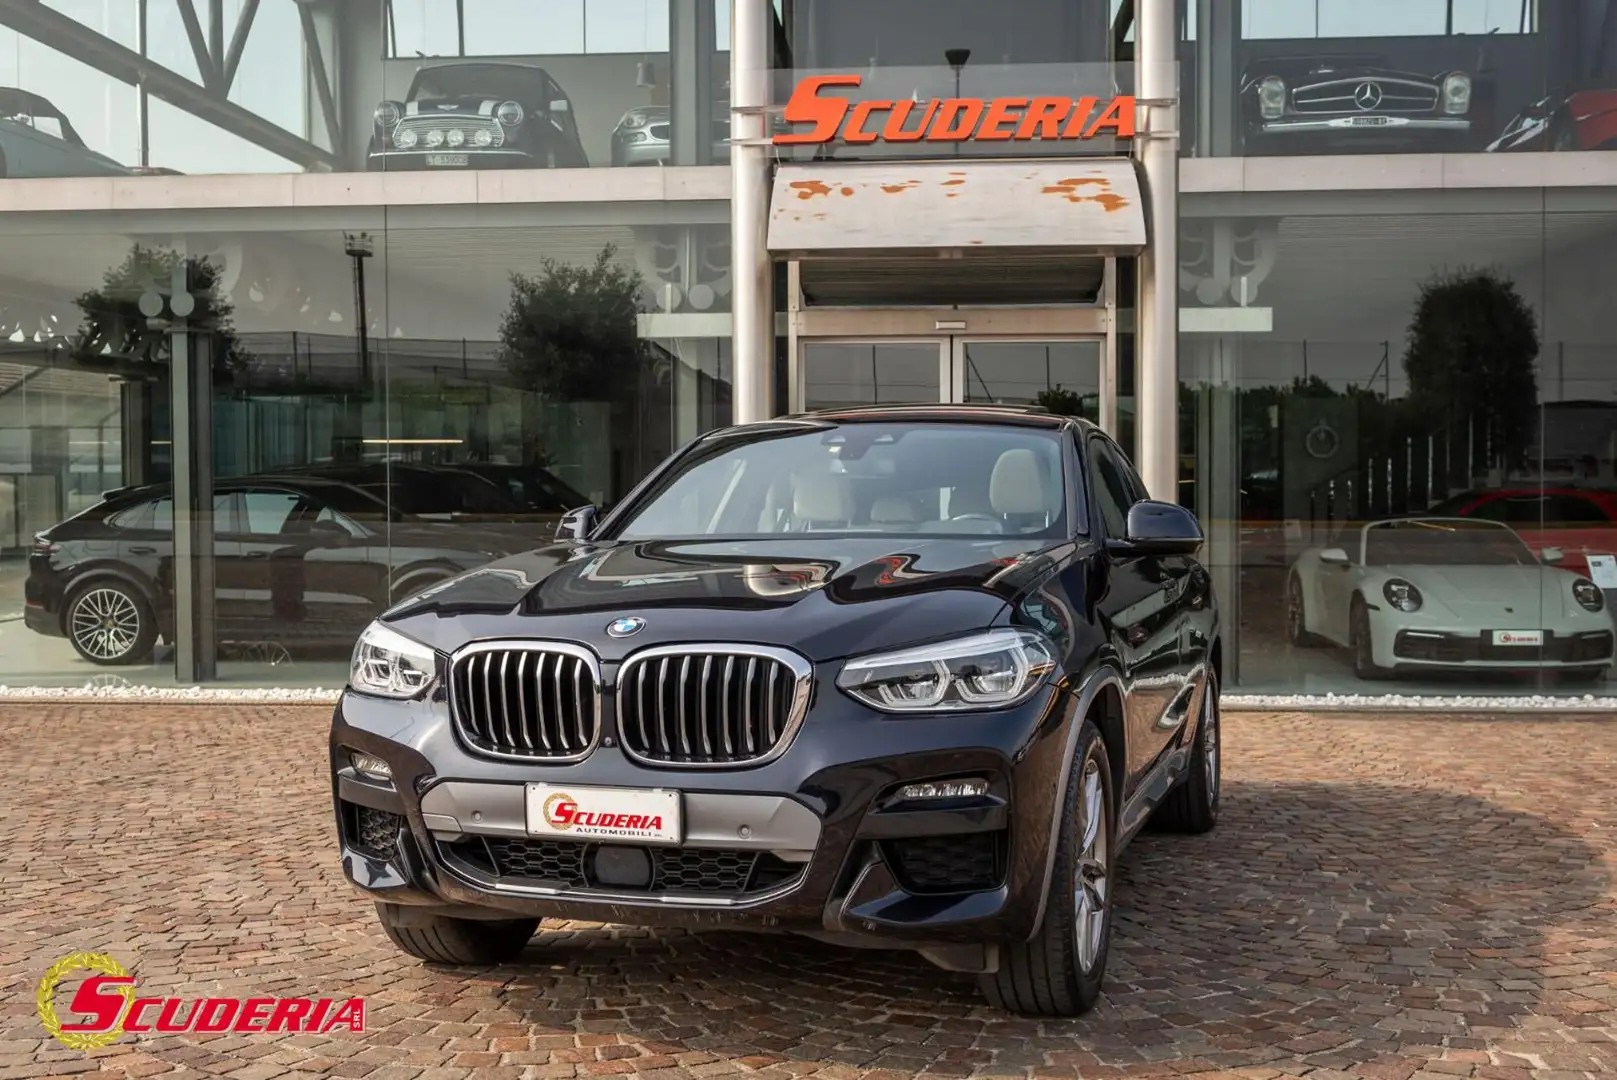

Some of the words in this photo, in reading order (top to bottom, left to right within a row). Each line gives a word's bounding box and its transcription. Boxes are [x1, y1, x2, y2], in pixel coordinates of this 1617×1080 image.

[772, 75, 1135, 144] SCUDERIA
[551, 802, 662, 830] SCUDERIA
[576, 827, 652, 837] AUTOMOBILI
